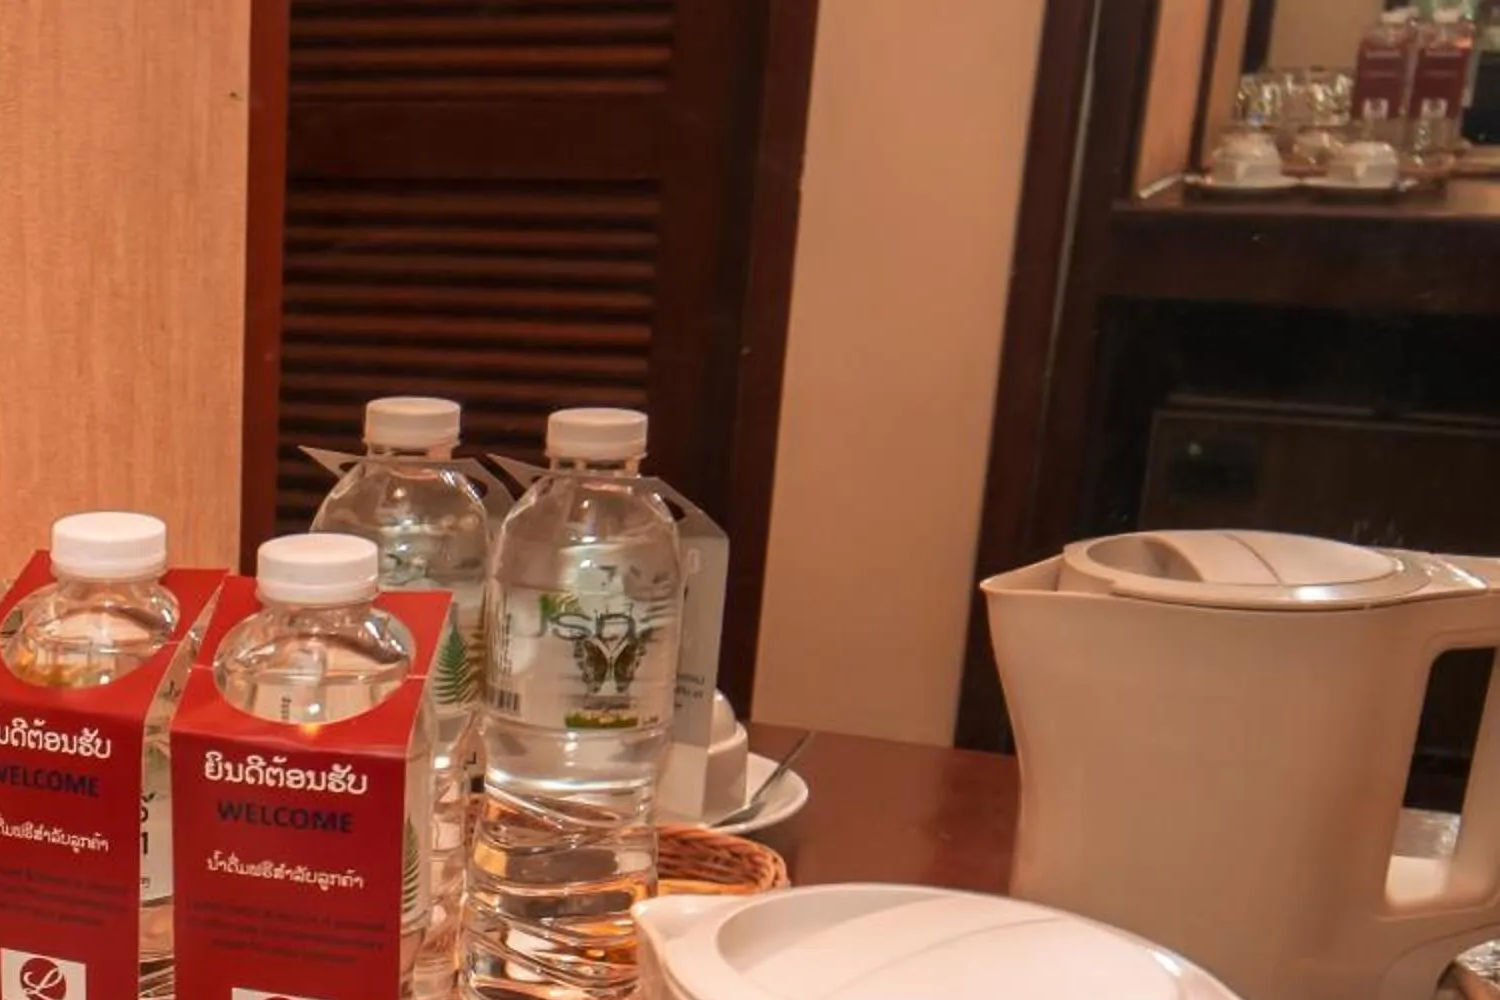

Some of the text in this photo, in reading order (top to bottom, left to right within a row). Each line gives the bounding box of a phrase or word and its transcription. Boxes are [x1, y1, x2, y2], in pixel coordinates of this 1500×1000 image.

[203, 749, 370, 796] ຍິນດີຕ້ອນຮັບ
[216, 799, 356, 833] WELCOME
